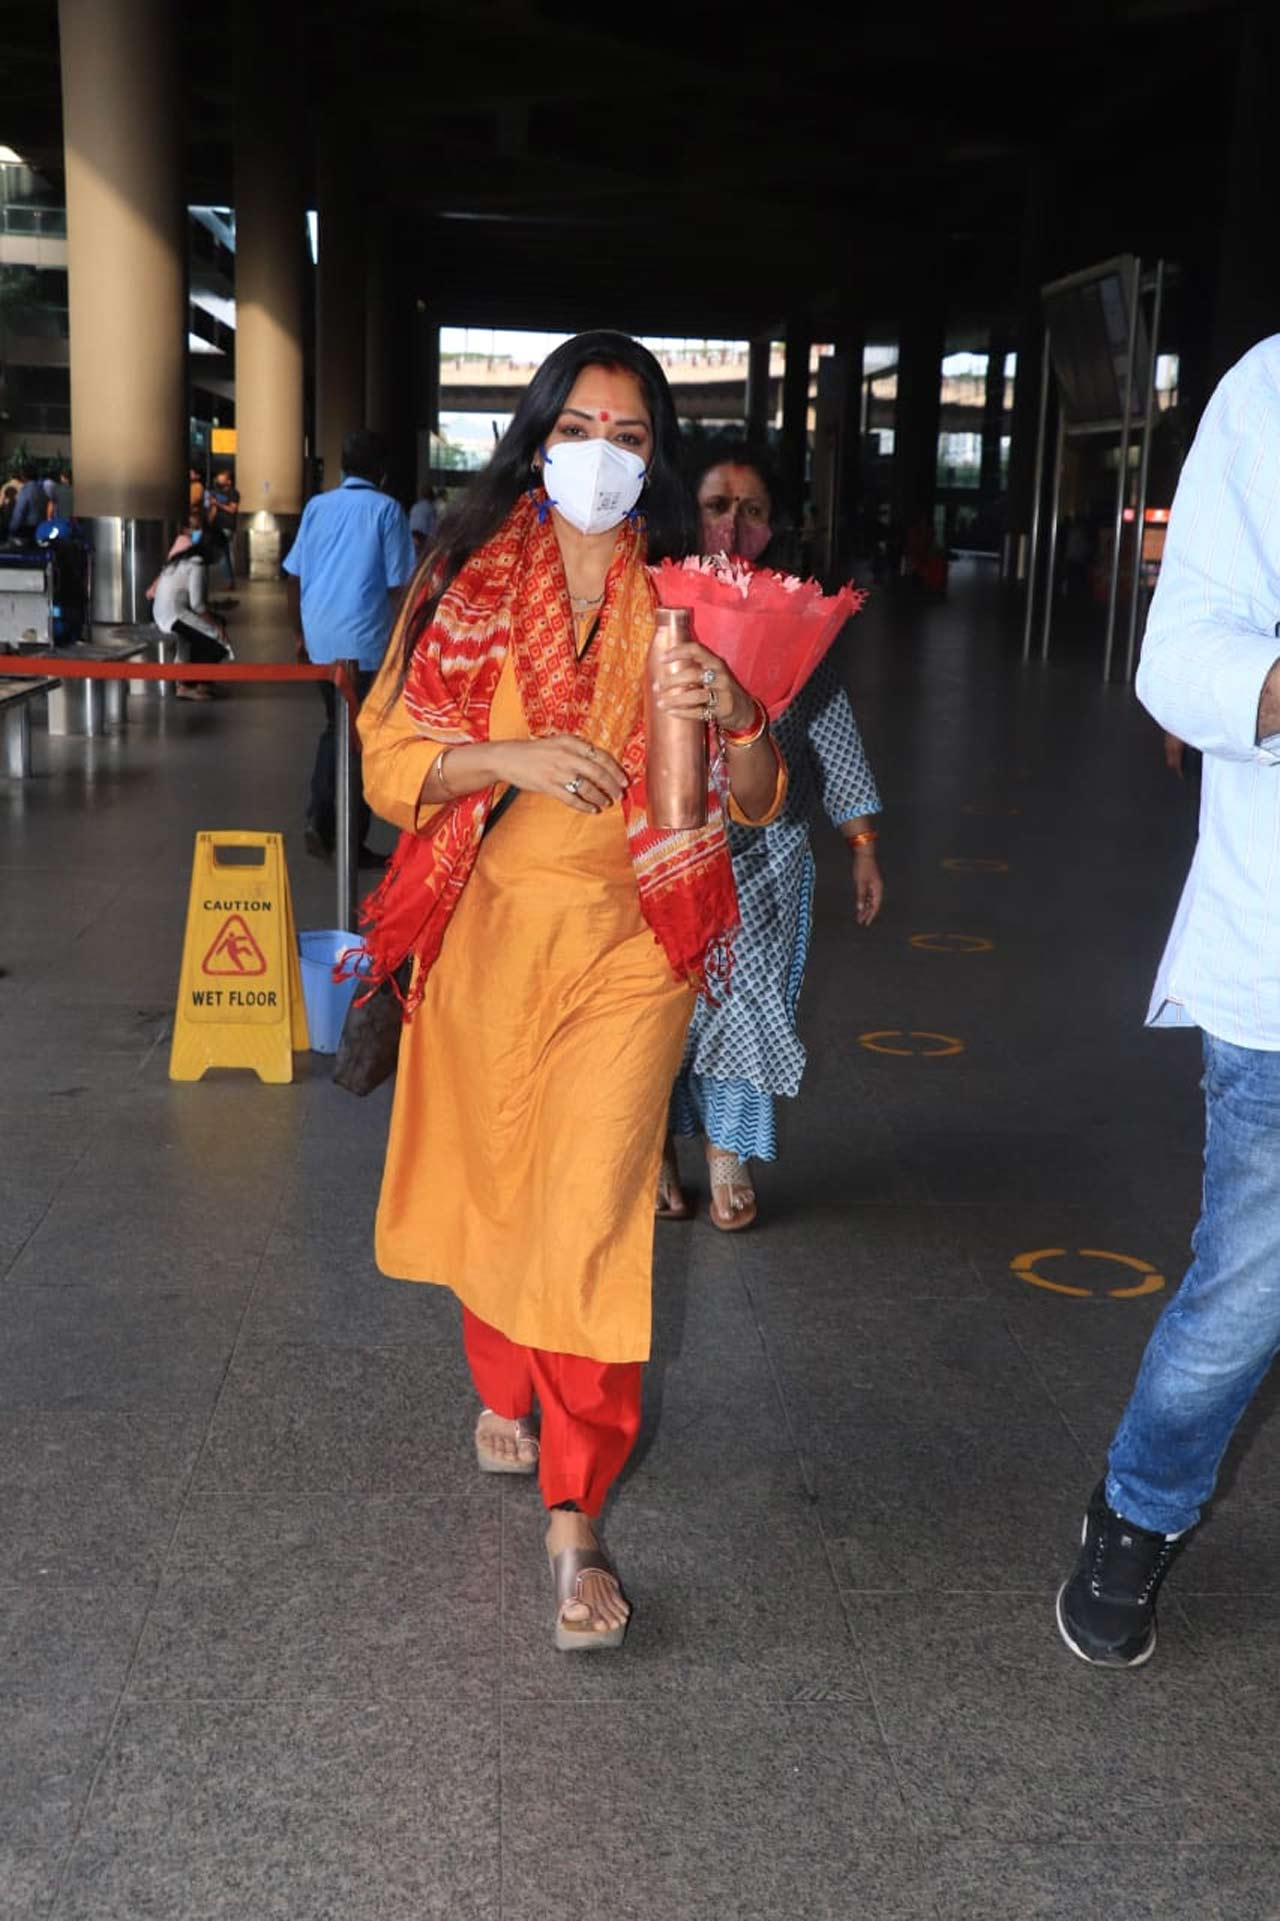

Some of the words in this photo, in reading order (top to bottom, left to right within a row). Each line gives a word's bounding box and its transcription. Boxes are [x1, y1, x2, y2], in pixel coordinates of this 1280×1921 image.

[203, 900, 272, 912] CAUTION
[192, 991, 223, 1007] WET
[229, 991, 277, 1007] FLOOR
